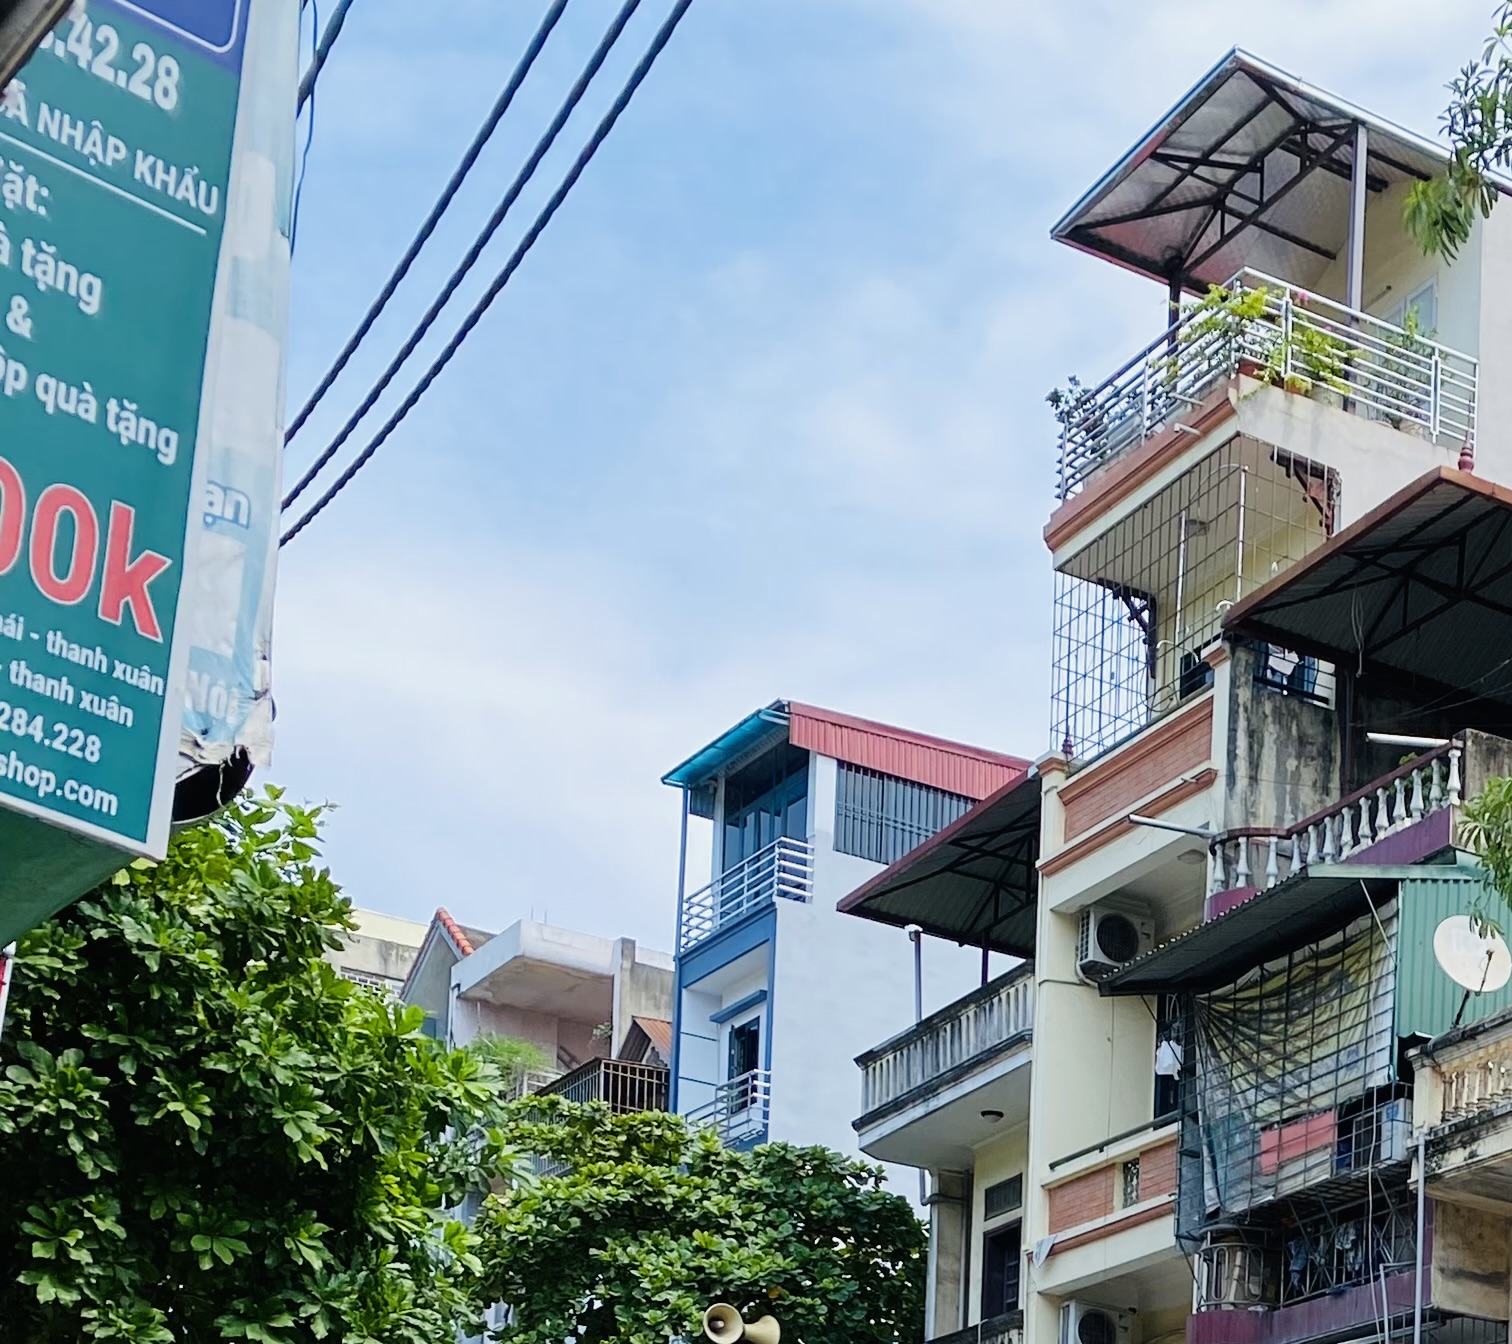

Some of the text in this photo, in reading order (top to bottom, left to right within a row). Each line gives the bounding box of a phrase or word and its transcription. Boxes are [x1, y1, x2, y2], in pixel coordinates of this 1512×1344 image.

[37, 102, 219, 214] NHẬP KHẨU
[21, 238, 102, 316] tặng
[6, 295, 33, 340] &
[35, 373, 178, 465] quà tặng
[9, 661, 133, 729] thanh xuân
[46, 629, 165, 697] thanh xuân
